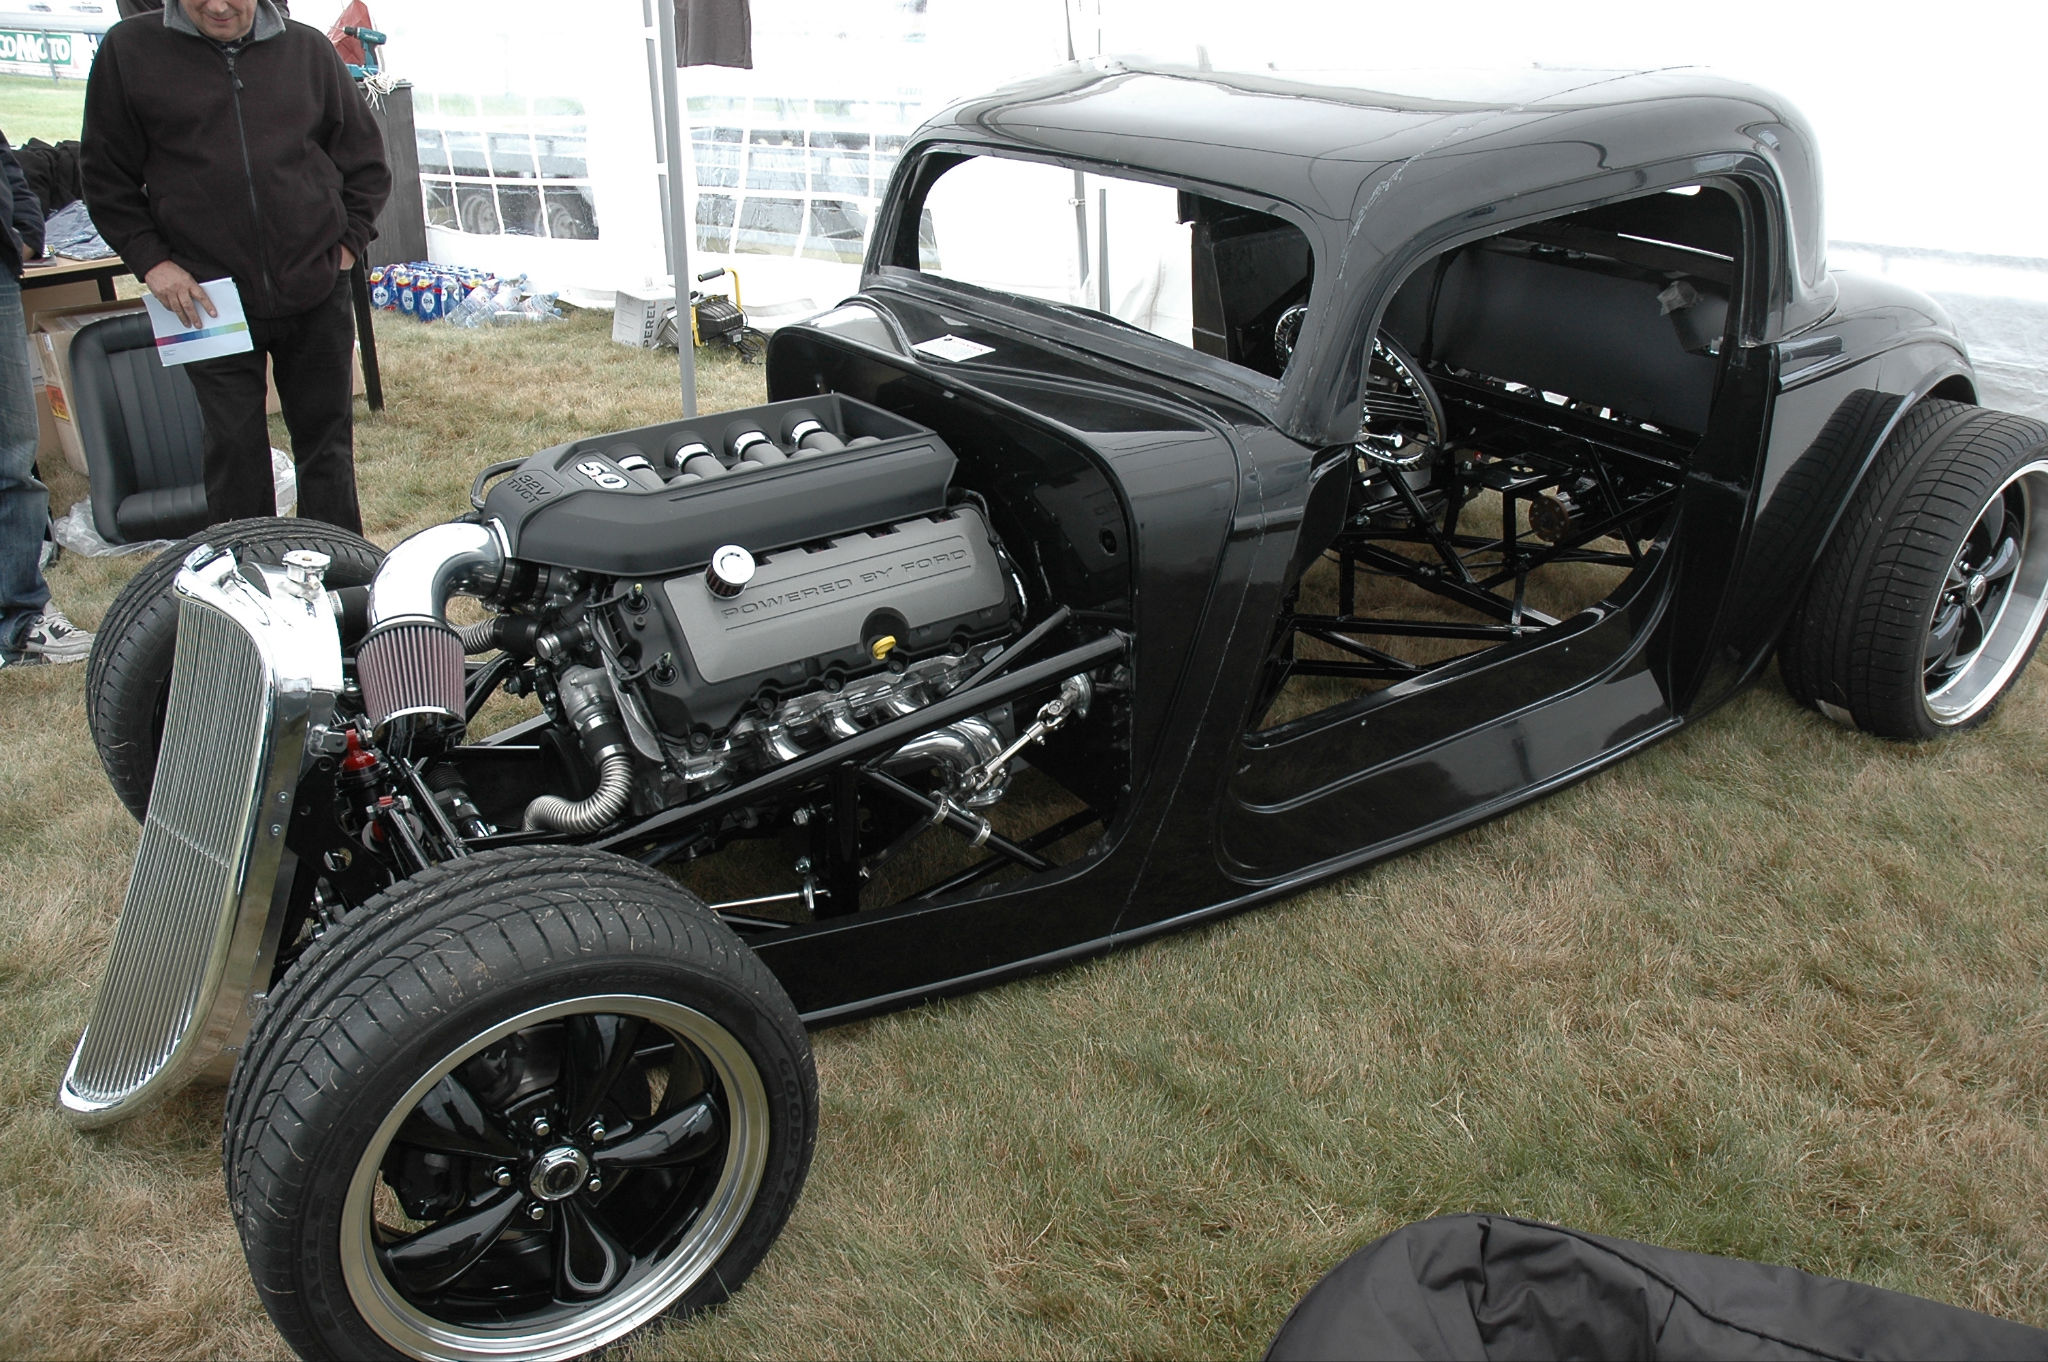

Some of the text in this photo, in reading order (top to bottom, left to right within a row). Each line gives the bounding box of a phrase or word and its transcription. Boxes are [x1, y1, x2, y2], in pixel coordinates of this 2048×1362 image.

[643, 301, 657, 348] PEREL
[518, 474, 551, 496] 32V
[576, 461, 629, 489] 5.0
[720, 549, 967, 619] POWERED BY FORD
